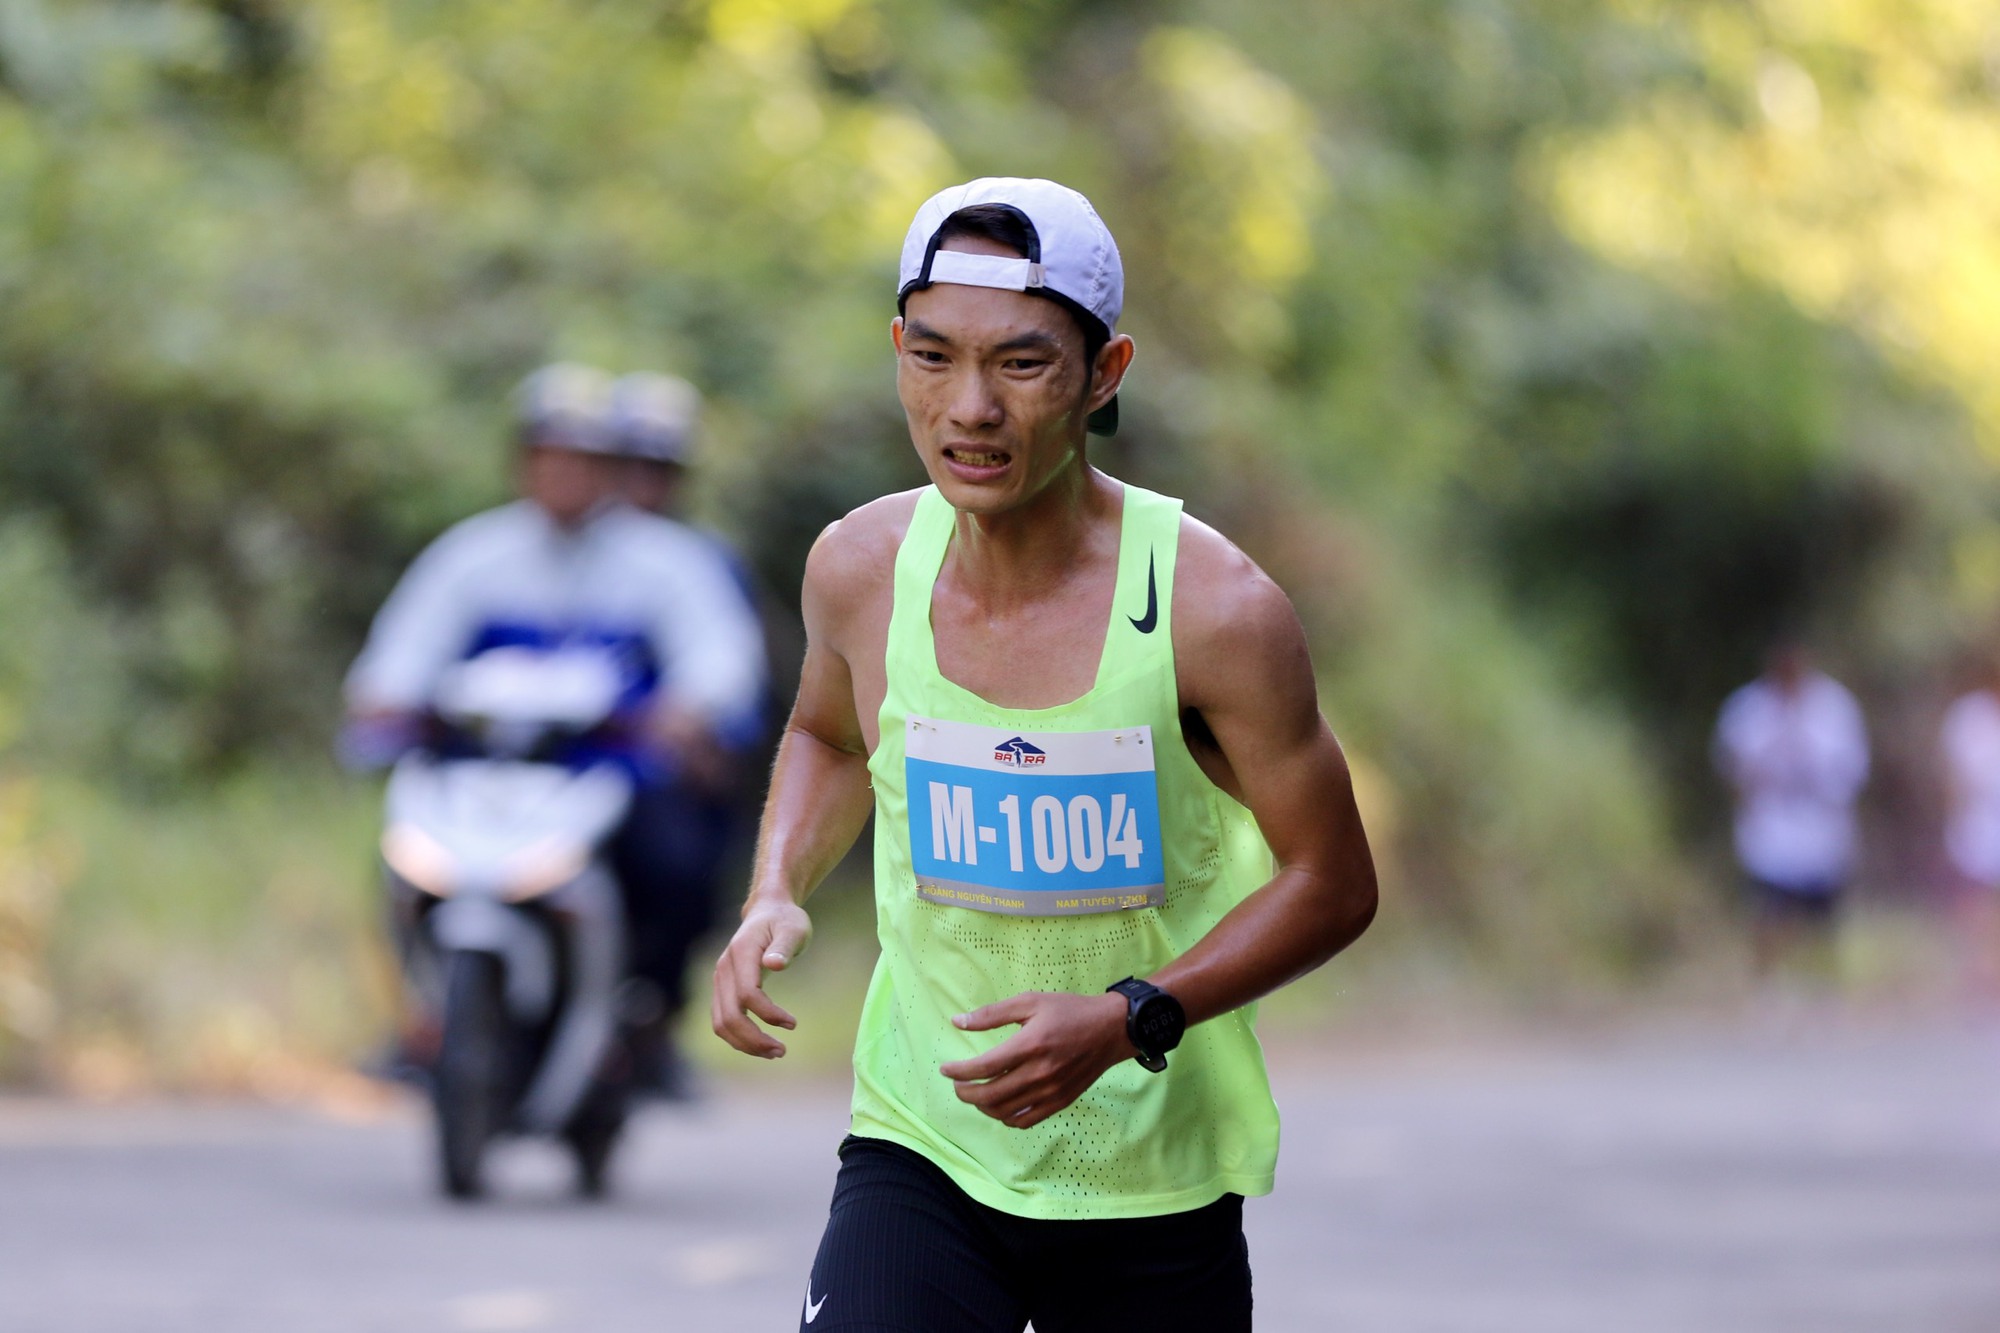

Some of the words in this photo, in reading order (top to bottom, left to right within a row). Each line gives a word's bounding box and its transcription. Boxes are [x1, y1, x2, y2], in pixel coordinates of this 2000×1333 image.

[929, 781, 1143, 874] M-1004
[993, 897, 1025, 909] THANH
[1056, 899, 1079, 909] NAM
